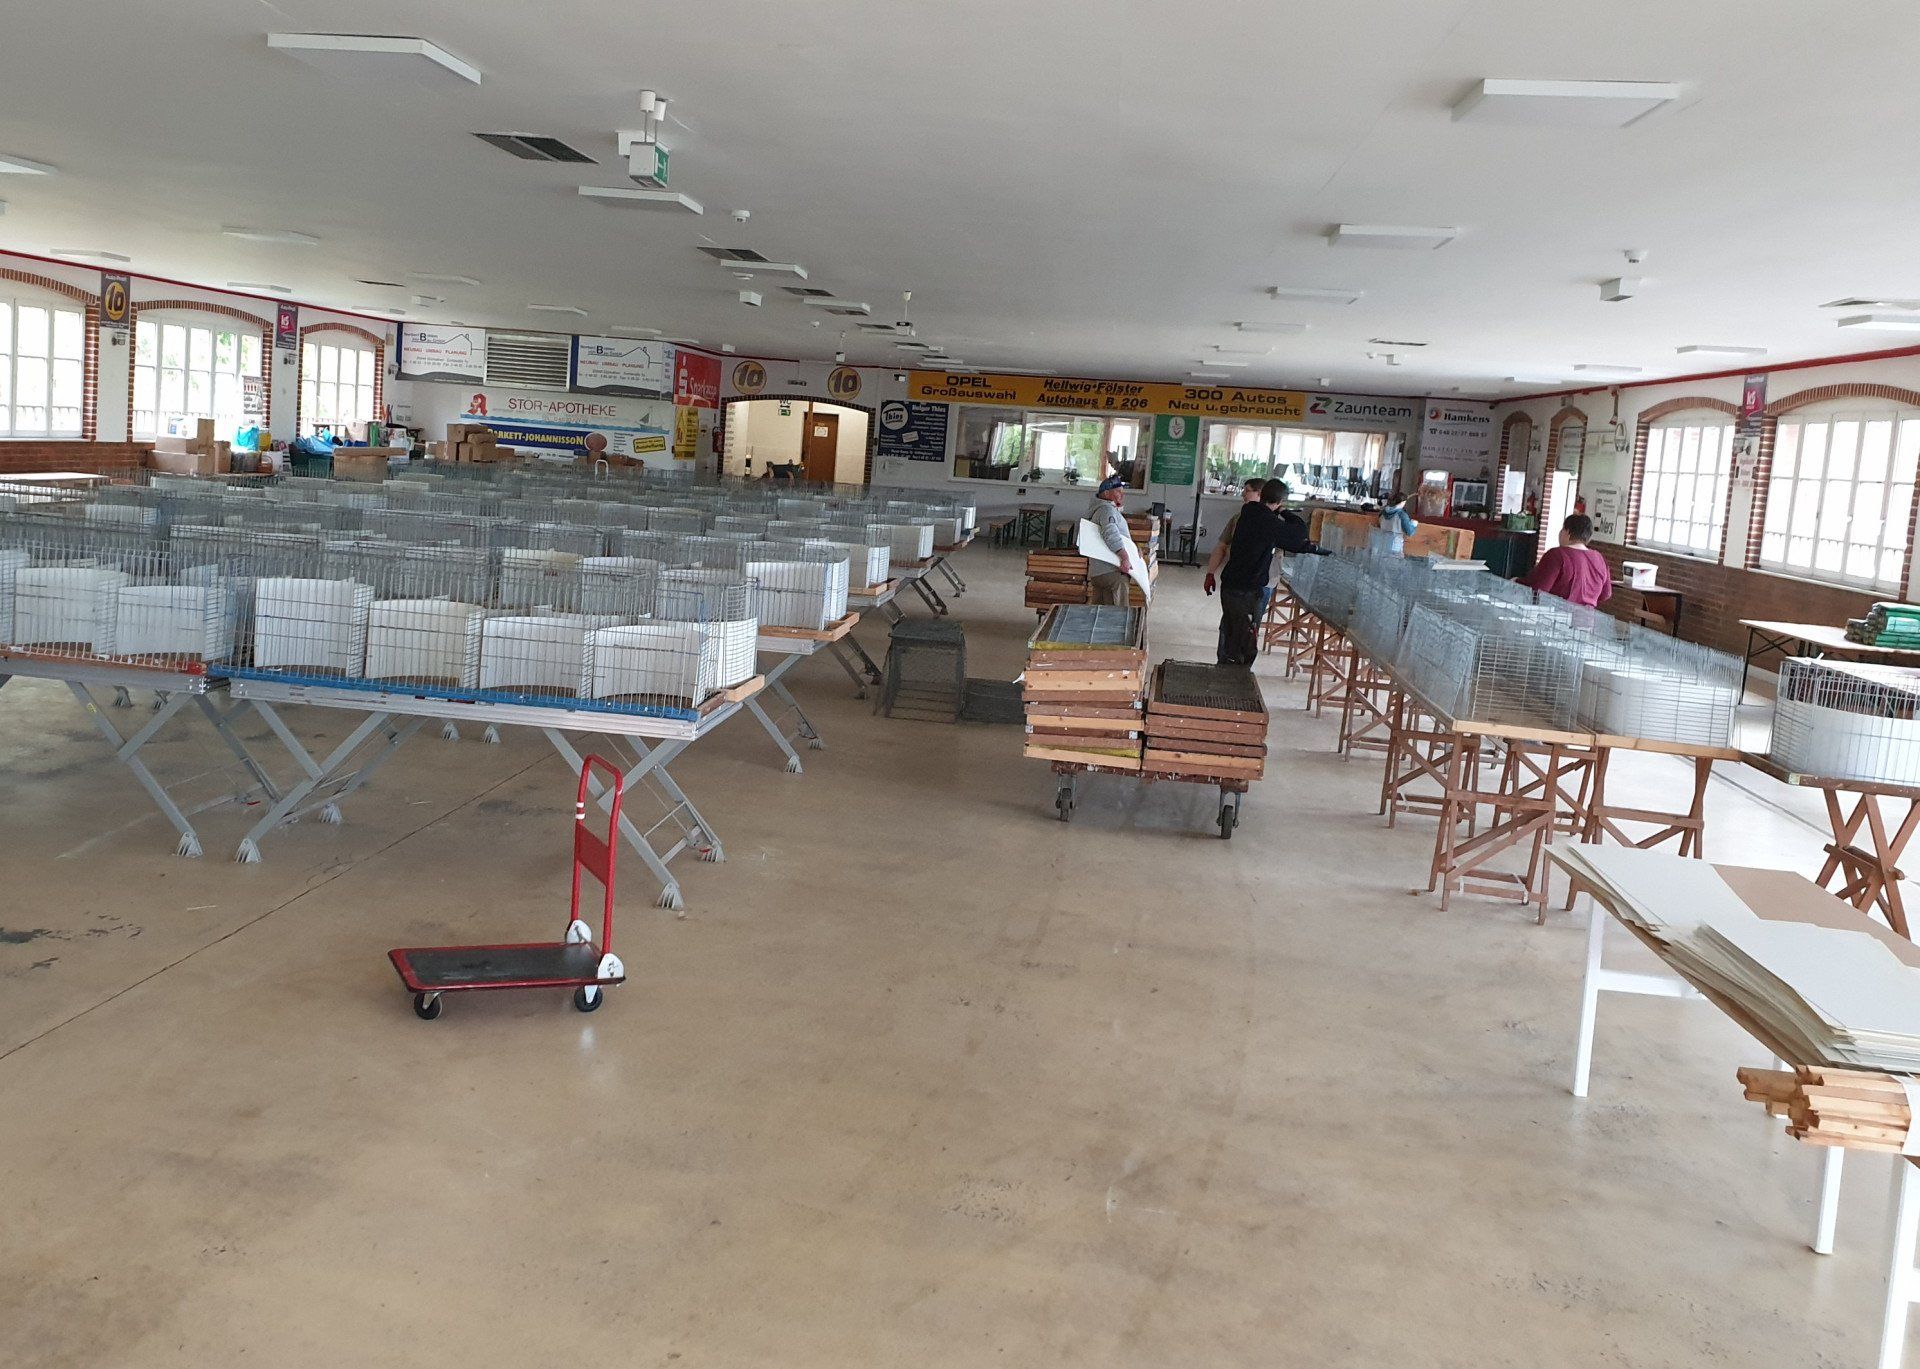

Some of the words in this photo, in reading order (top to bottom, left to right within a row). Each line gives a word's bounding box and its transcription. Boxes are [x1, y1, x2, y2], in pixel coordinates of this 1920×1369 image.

[946, 375, 992, 388] OPEL
[921, 385, 1017, 400] Großauswahl
[1184, 388, 1223, 400] 300
[1231, 391, 1287, 404] Autos
[1036, 393, 1099, 406] Autohaus
[1105, 397, 1115, 406] B
[1121, 398, 1149, 408] 206
[1168, 400, 1200, 411] Neu
[1334, 401, 1412, 418] Zaunteam
